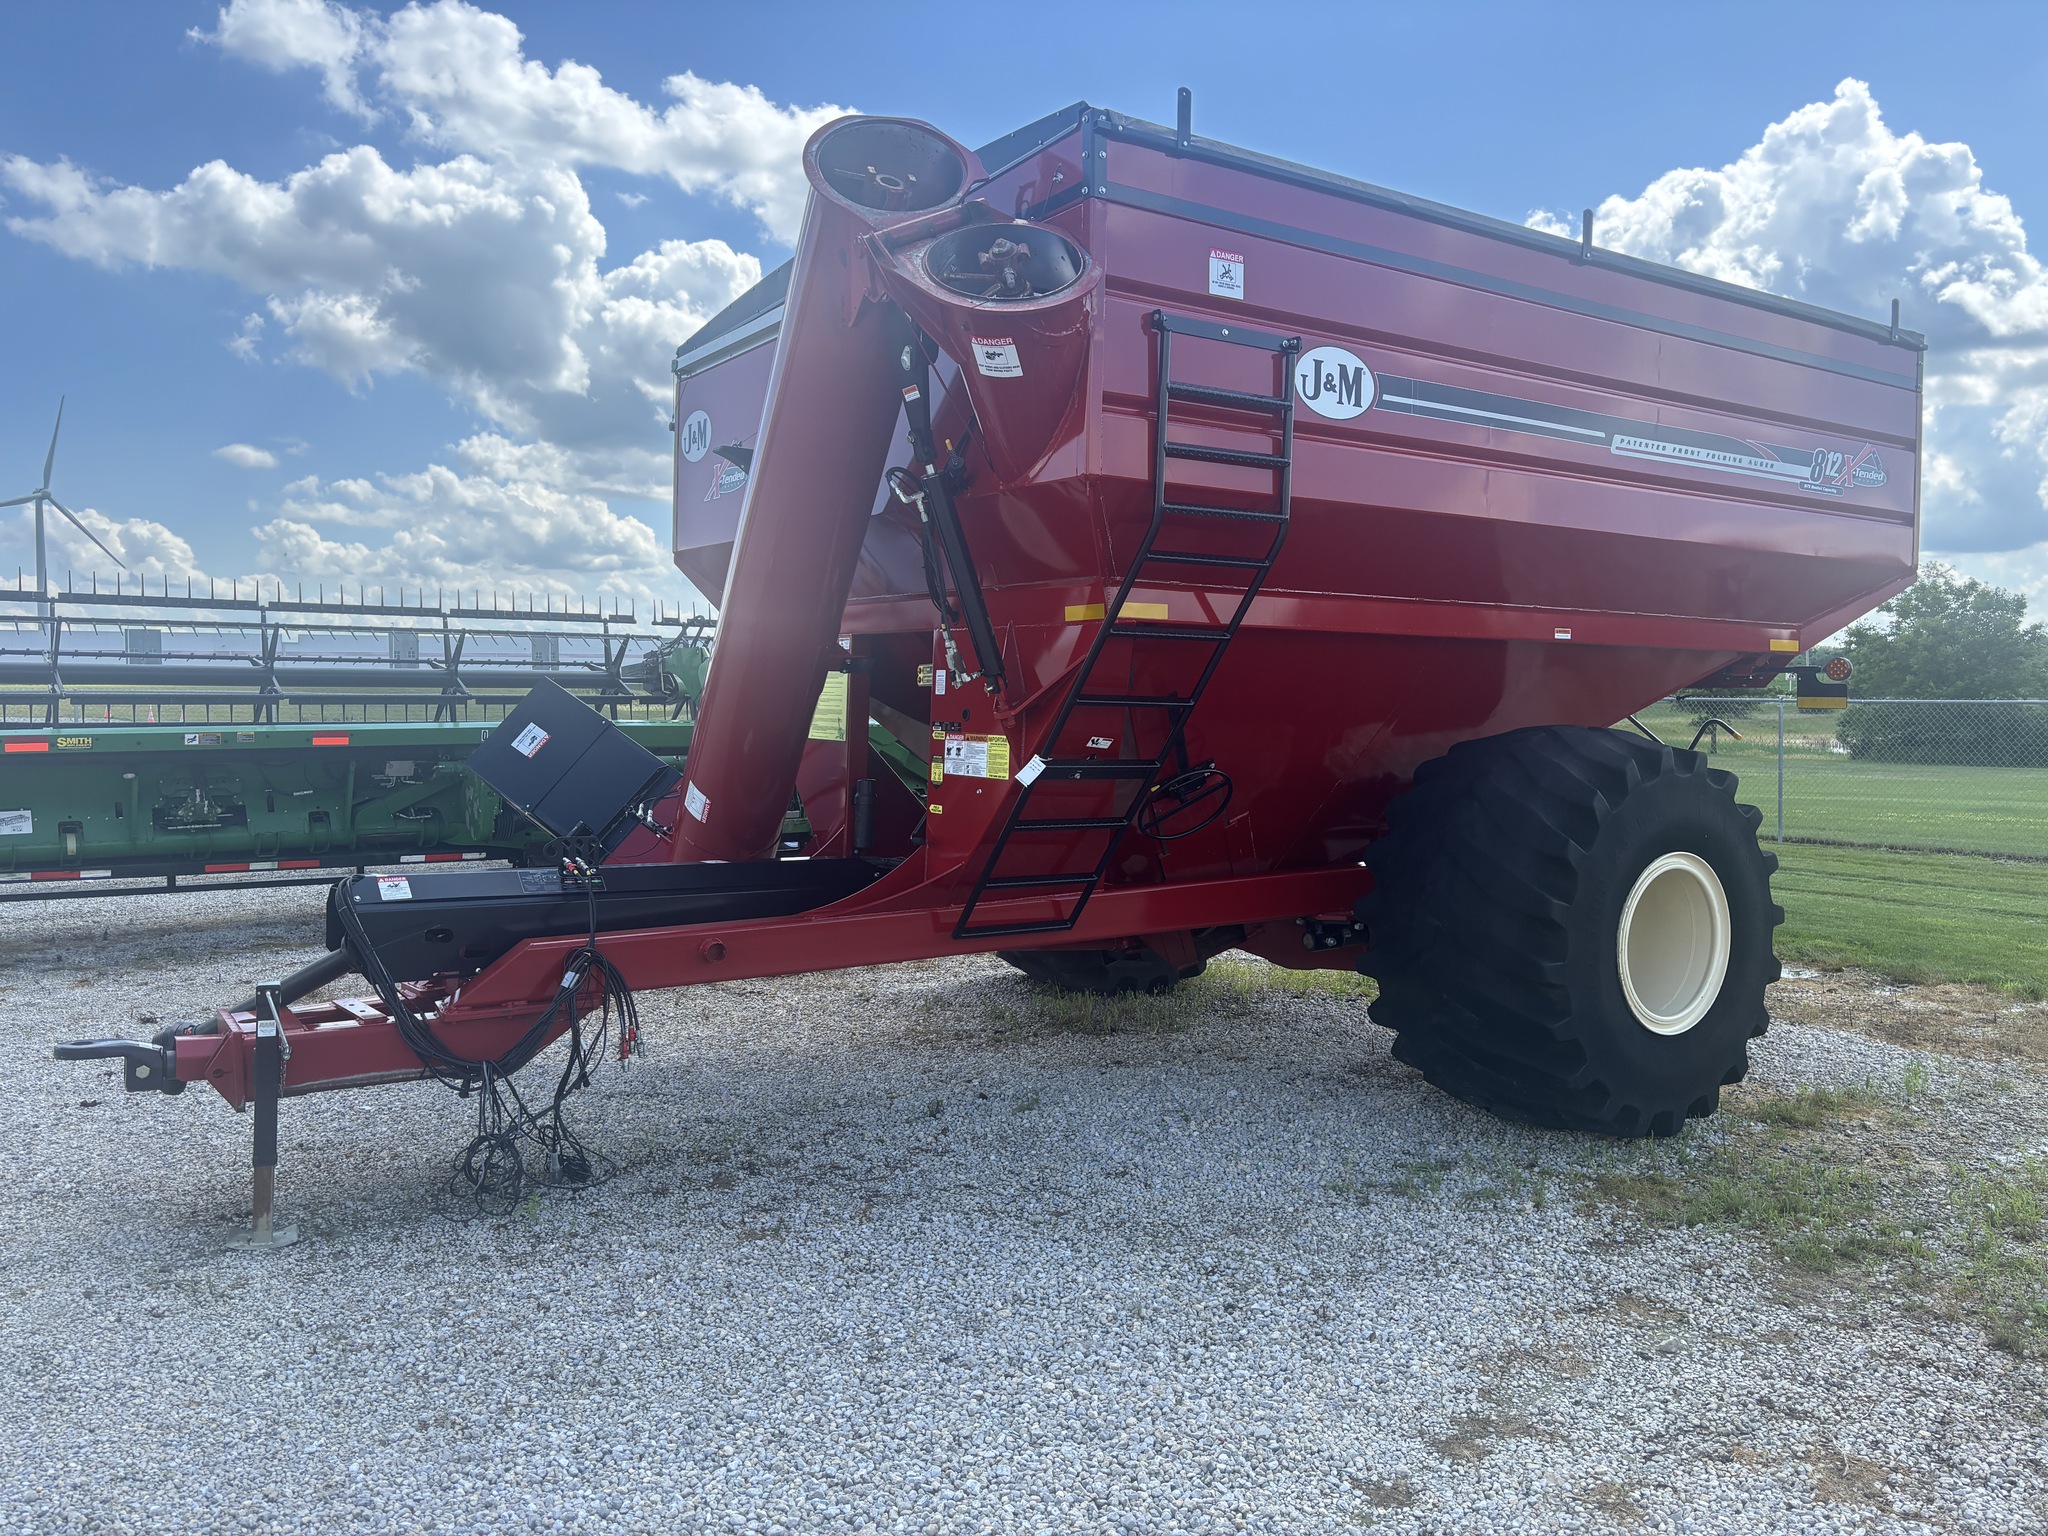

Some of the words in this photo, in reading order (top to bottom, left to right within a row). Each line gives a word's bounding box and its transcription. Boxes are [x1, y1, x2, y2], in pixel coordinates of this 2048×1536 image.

[1216, 251, 1244, 263] DANGER
[977, 337, 1013, 346] DANGER
[1300, 358, 1364, 408] J&M
[683, 418, 708, 455] J&M
[1619, 438, 1667, 451] PATENTED
[1672, 446, 1701, 457] FRONT
[1706, 452, 1743, 464] FOLDING
[1747, 459, 1775, 469] AUGER
[1809, 448, 1842, 484] 812
[57, 737, 92, 747] SMITH
[528, 738, 547, 758] DANGER
[969, 735, 988, 743] WARNING
